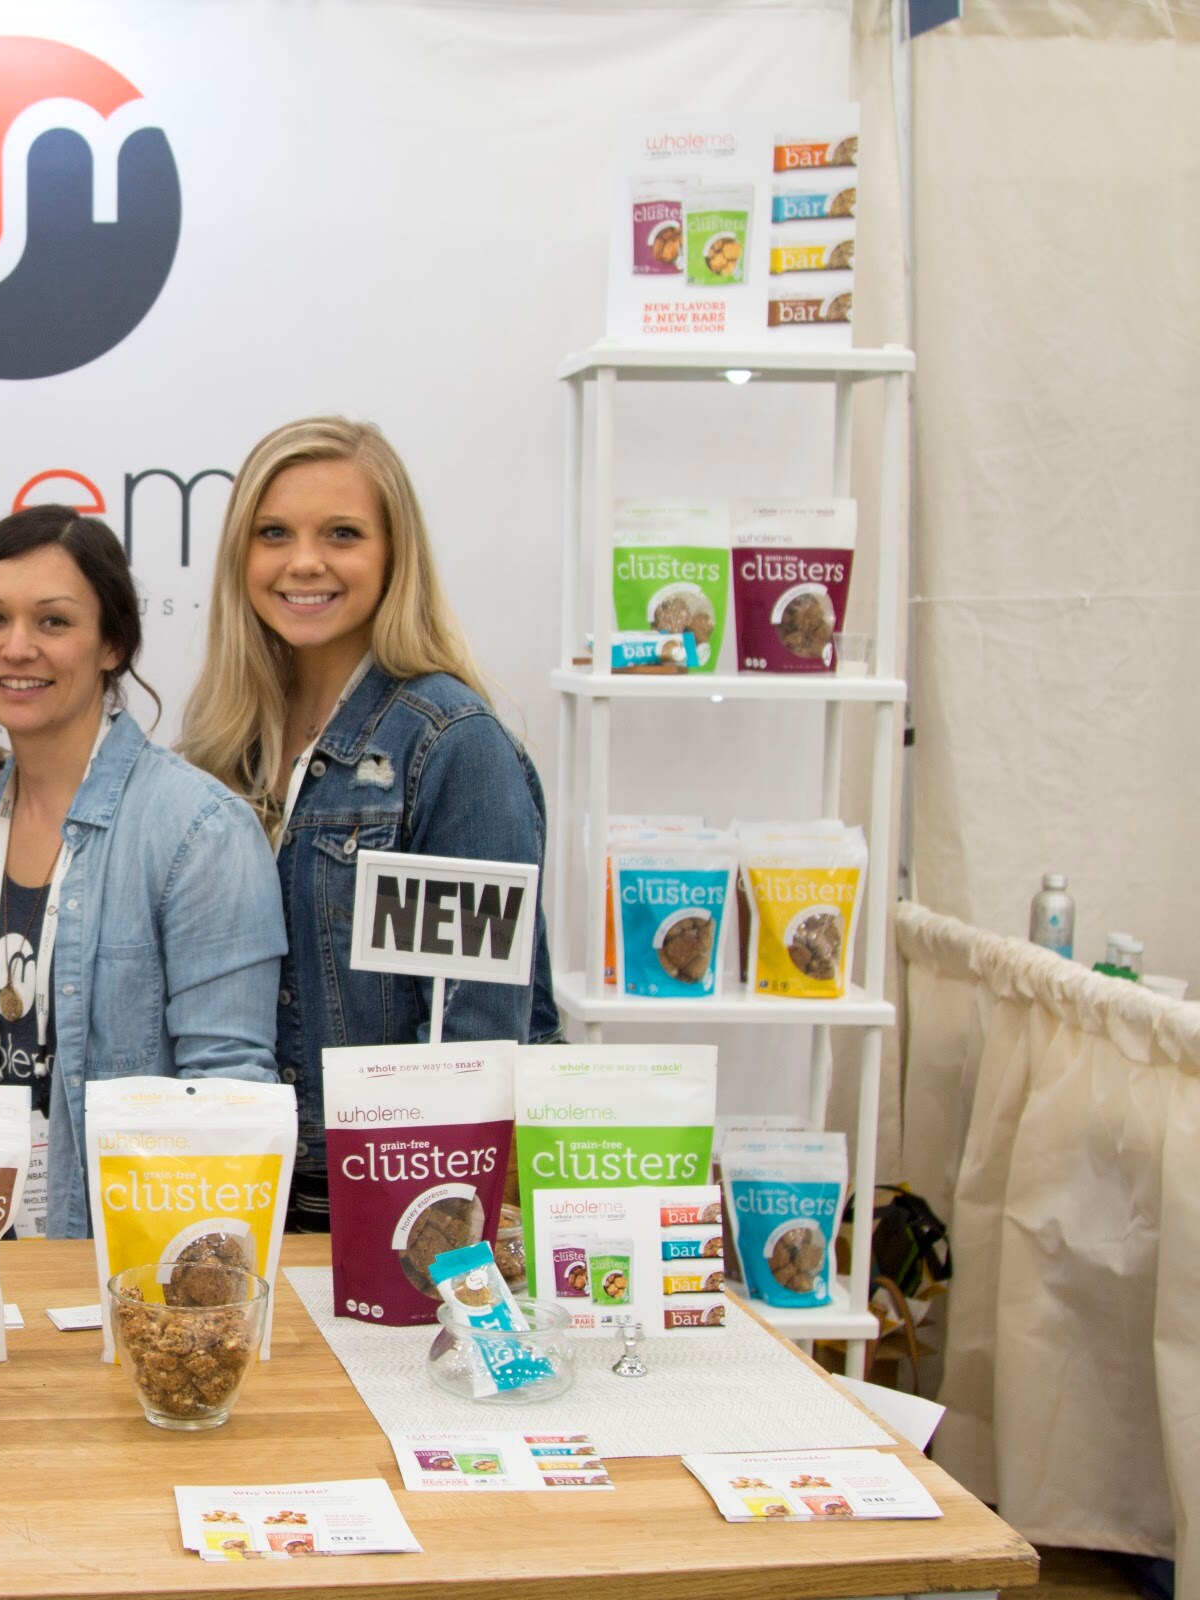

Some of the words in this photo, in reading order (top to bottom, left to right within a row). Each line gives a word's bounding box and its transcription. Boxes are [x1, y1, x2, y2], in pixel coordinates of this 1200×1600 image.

[784, 146, 824, 168] bar
[782, 198, 820, 218] bar
[780, 249, 820, 270] bar
[644, 302, 671, 312] NEW
[675, 301, 726, 311] FLAVORS
[778, 302, 818, 323] bar
[656, 312, 689, 323] NEW
[692, 312, 725, 322] BARS
[643, 324, 690, 334] COMING
[694, 323, 725, 333] SOON
[616, 554, 720, 582] clusters
[740, 553, 845, 583] clusters
[622, 643, 654, 659] bar
[621, 877, 725, 905] clusters
[371, 875, 525, 961] NEW
[358, 1066, 365, 1074] a
[367, 1063, 397, 1073] whole
[399, 1064, 419, 1072] new
[421, 1063, 441, 1074] way
[443, 1062, 454, 1070] to
[454, 1060, 485, 1070] snack!
[559, 1062, 590, 1072] whole
[592, 1064, 615, 1072] new
[616, 1064, 637, 1075] way
[650, 1062, 683, 1072] snack!
[337, 1104, 425, 1123] wholeme.
[526, 1103, 617, 1122] wholeme.
[380, 1139, 430, 1152] grain-free
[570, 1139, 623, 1151] grain-free
[341, 1142, 498, 1182] clusters
[531, 1141, 699, 1180] clusters
[143, 1170, 198, 1181] grain-free
[104, 1170, 273, 1212] clusters
[400, 1207, 419, 1232] honey
[417, 1189, 449, 1209] espresso
[735, 1188, 836, 1217] clusters
[667, 1209, 697, 1223] bar
[553, 1250, 585, 1263] cluste
[669, 1243, 698, 1257] bar
[671, 1278, 699, 1292] bar
[671, 1311, 700, 1326] bar
